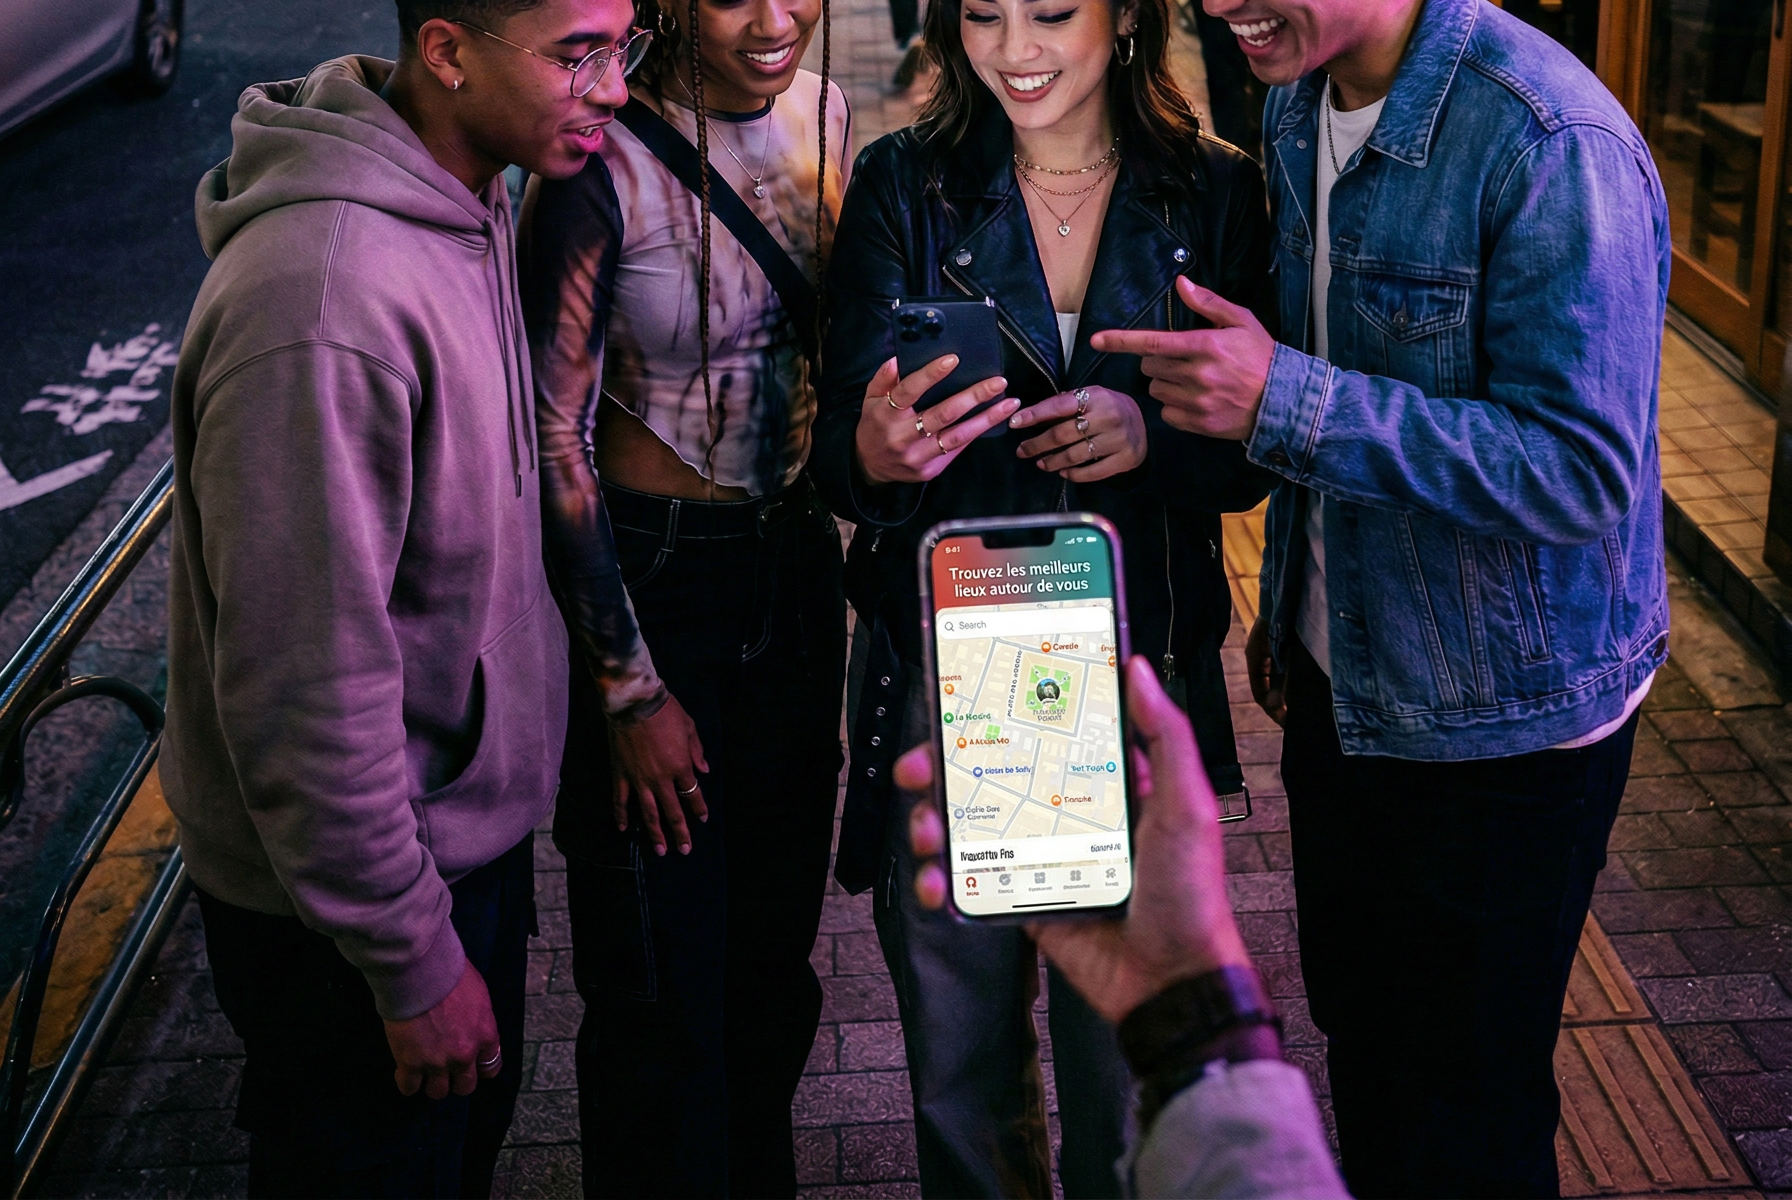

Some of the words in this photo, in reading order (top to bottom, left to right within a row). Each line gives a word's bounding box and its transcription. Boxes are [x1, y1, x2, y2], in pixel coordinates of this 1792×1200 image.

[949, 566, 1003, 581] Trouvez
[1006, 562, 1026, 577] les
[1029, 560, 1091, 575] meilleurs
[954, 584, 987, 598] lieux
[989, 582, 1033, 596] autour
[1036, 579, 1054, 593] de
[1056, 579, 1089, 591] vous
[958, 620, 987, 630] Search
